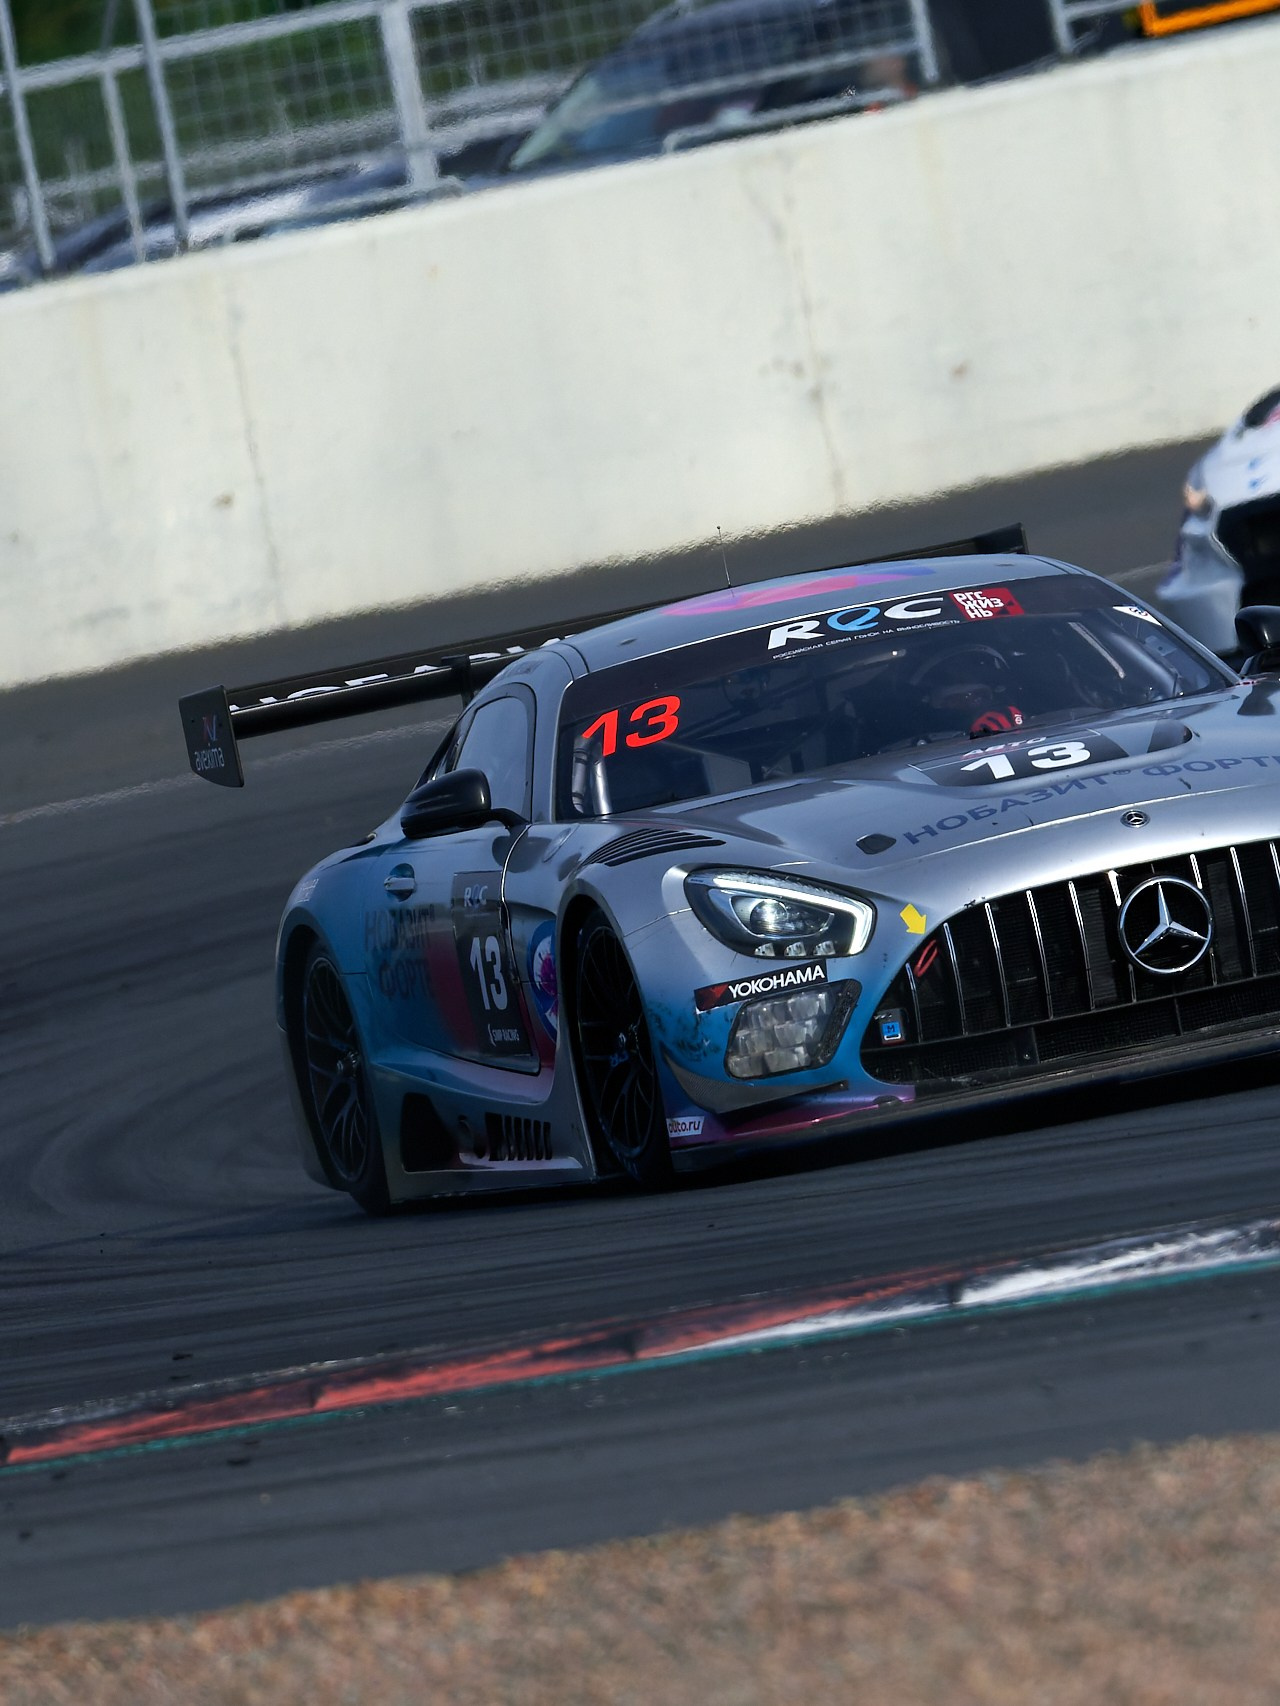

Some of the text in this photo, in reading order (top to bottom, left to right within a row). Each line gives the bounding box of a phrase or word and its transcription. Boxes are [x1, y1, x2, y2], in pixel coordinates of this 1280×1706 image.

[582, 695, 681, 757] 13
[960, 741, 1091, 781] 13
[470, 935, 508, 1011] 13
[728, 964, 826, 999] YOKOHAMA
[668, 1119, 701, 1136] auto.ru
